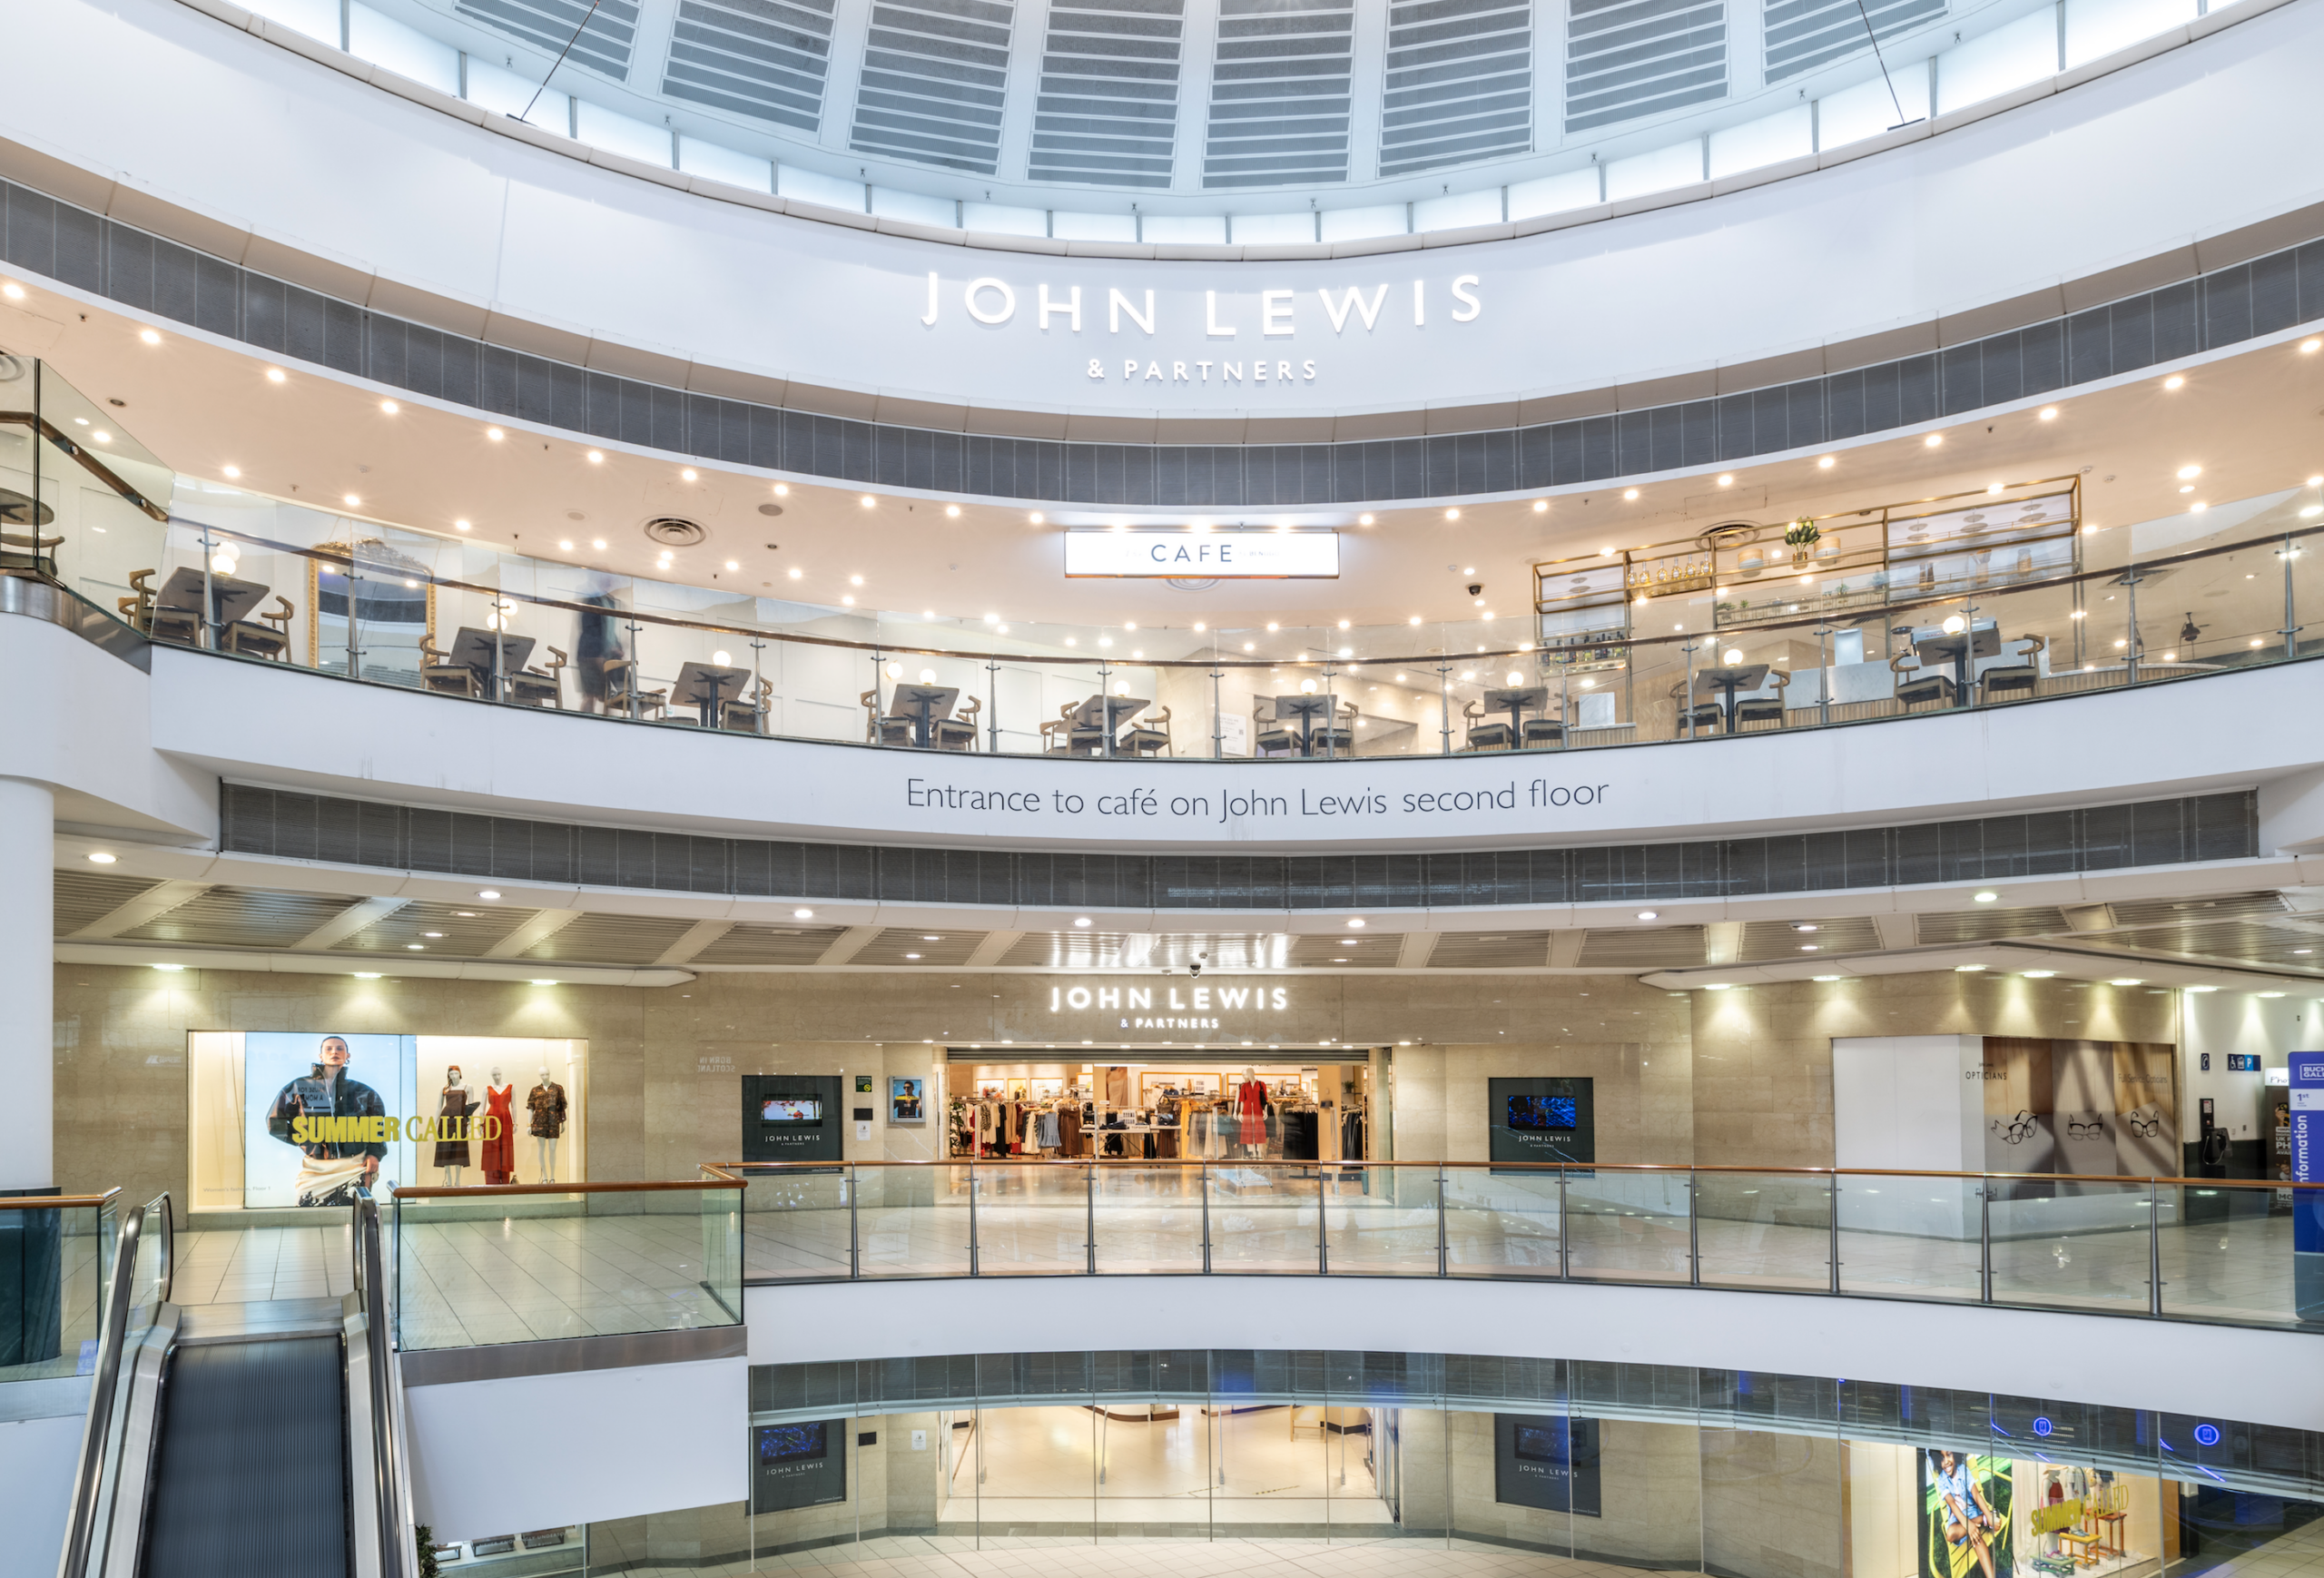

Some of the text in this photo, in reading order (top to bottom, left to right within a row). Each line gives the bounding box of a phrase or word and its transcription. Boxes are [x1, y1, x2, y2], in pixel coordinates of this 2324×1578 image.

[921, 271, 1482, 336] JOHN LEWIS
[1088, 359, 1316, 381] & PARTNERS
[1151, 544, 1233, 563] CAFE
[908, 778, 1610, 824] Entrance to café on John Lewis second floor
[1049, 987, 1287, 1012] JOHN LEWIS
[1120, 1018, 1219, 1029] & PARTNERS
[1965, 1070, 2007, 1080] OPTICIANS
[2145, 1073, 2168, 1086] Opticians
[2297, 1093, 2309, 1101] 1st
[291, 1116, 502, 1143] SUMMER CALLED
[2293, 1115, 2309, 1183] nformation
[766, 1462, 823, 1475] JOHN LEWIS
[1519, 1465, 1578, 1478] JOHN LEWS
[2031, 1484, 2129, 1537] SUMMER CALLED
